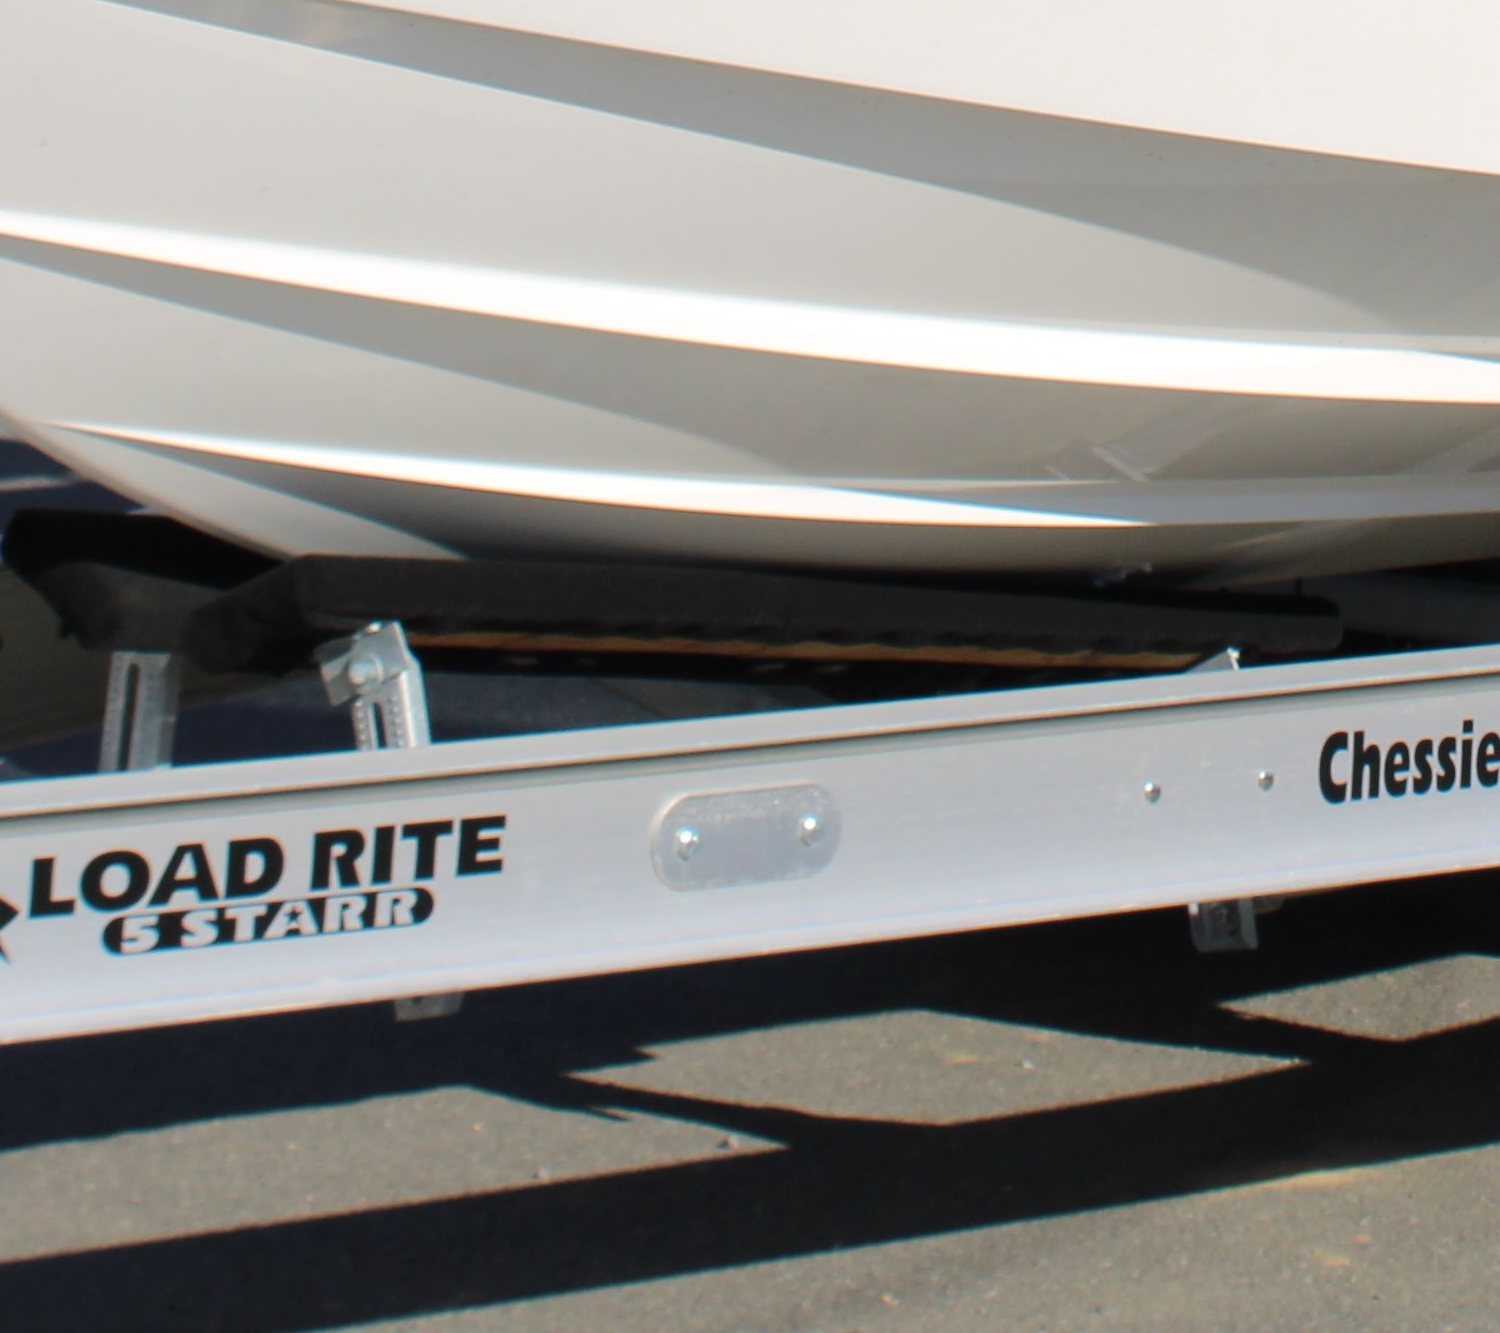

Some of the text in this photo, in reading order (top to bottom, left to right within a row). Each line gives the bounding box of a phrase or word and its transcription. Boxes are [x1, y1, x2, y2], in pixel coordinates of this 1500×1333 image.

[28, 815, 507, 920] LOAD RITE
[119, 887, 419, 955] 5 STARR
